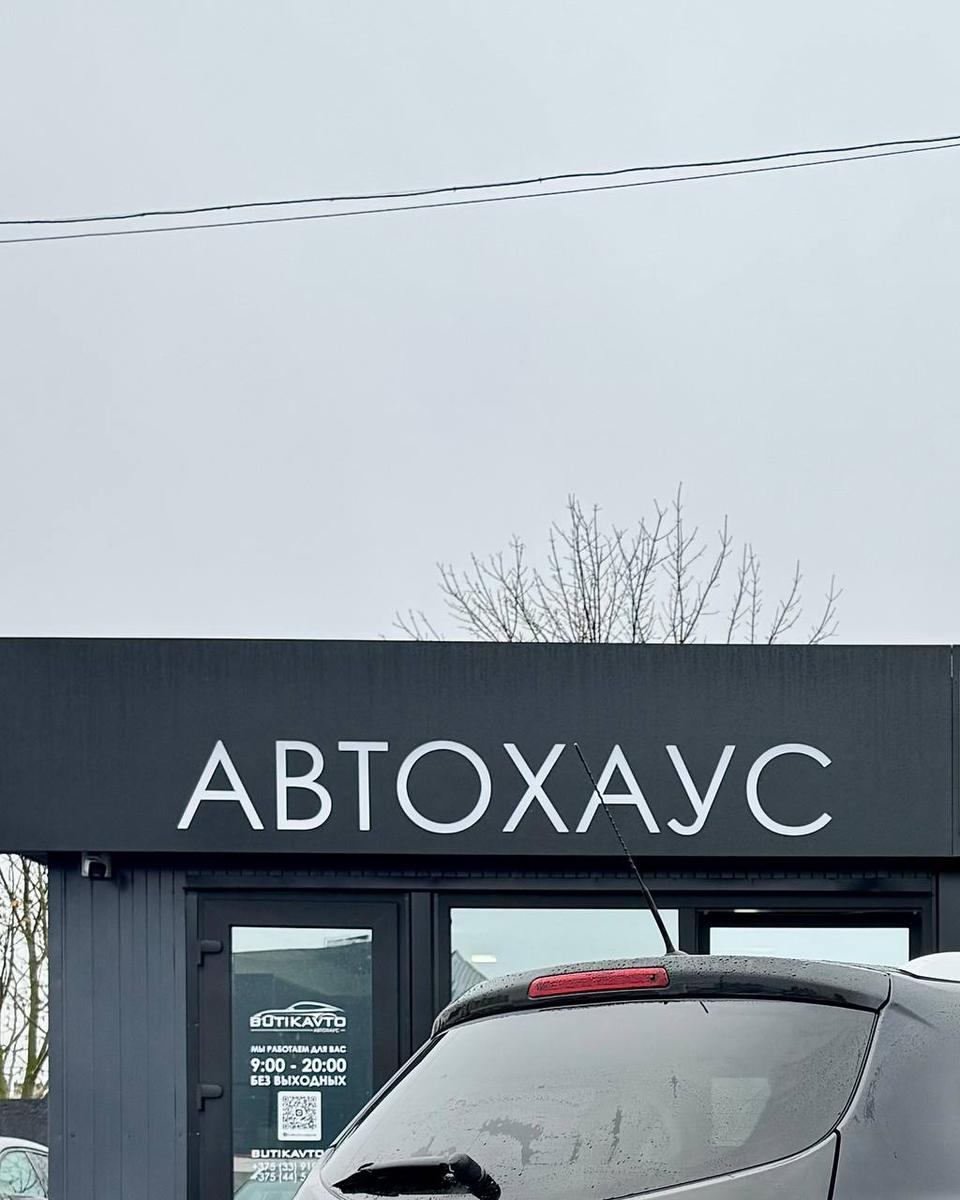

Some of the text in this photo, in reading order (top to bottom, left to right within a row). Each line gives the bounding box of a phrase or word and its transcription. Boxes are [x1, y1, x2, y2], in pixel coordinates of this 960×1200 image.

[177, 739, 832, 836] АВТОХАУС
[249, 1015, 346, 1028] BUTIKAVTO
[250, 1045, 347, 1054] МЫ РАБОТАЕМ ДЛЯ ВАС
[250, 1057, 285, 1073] 9:00
[301, 1057, 347, 1073] 20:00
[250, 1075, 347, 1087] БЕЗ ВЫХОДНЫХ
